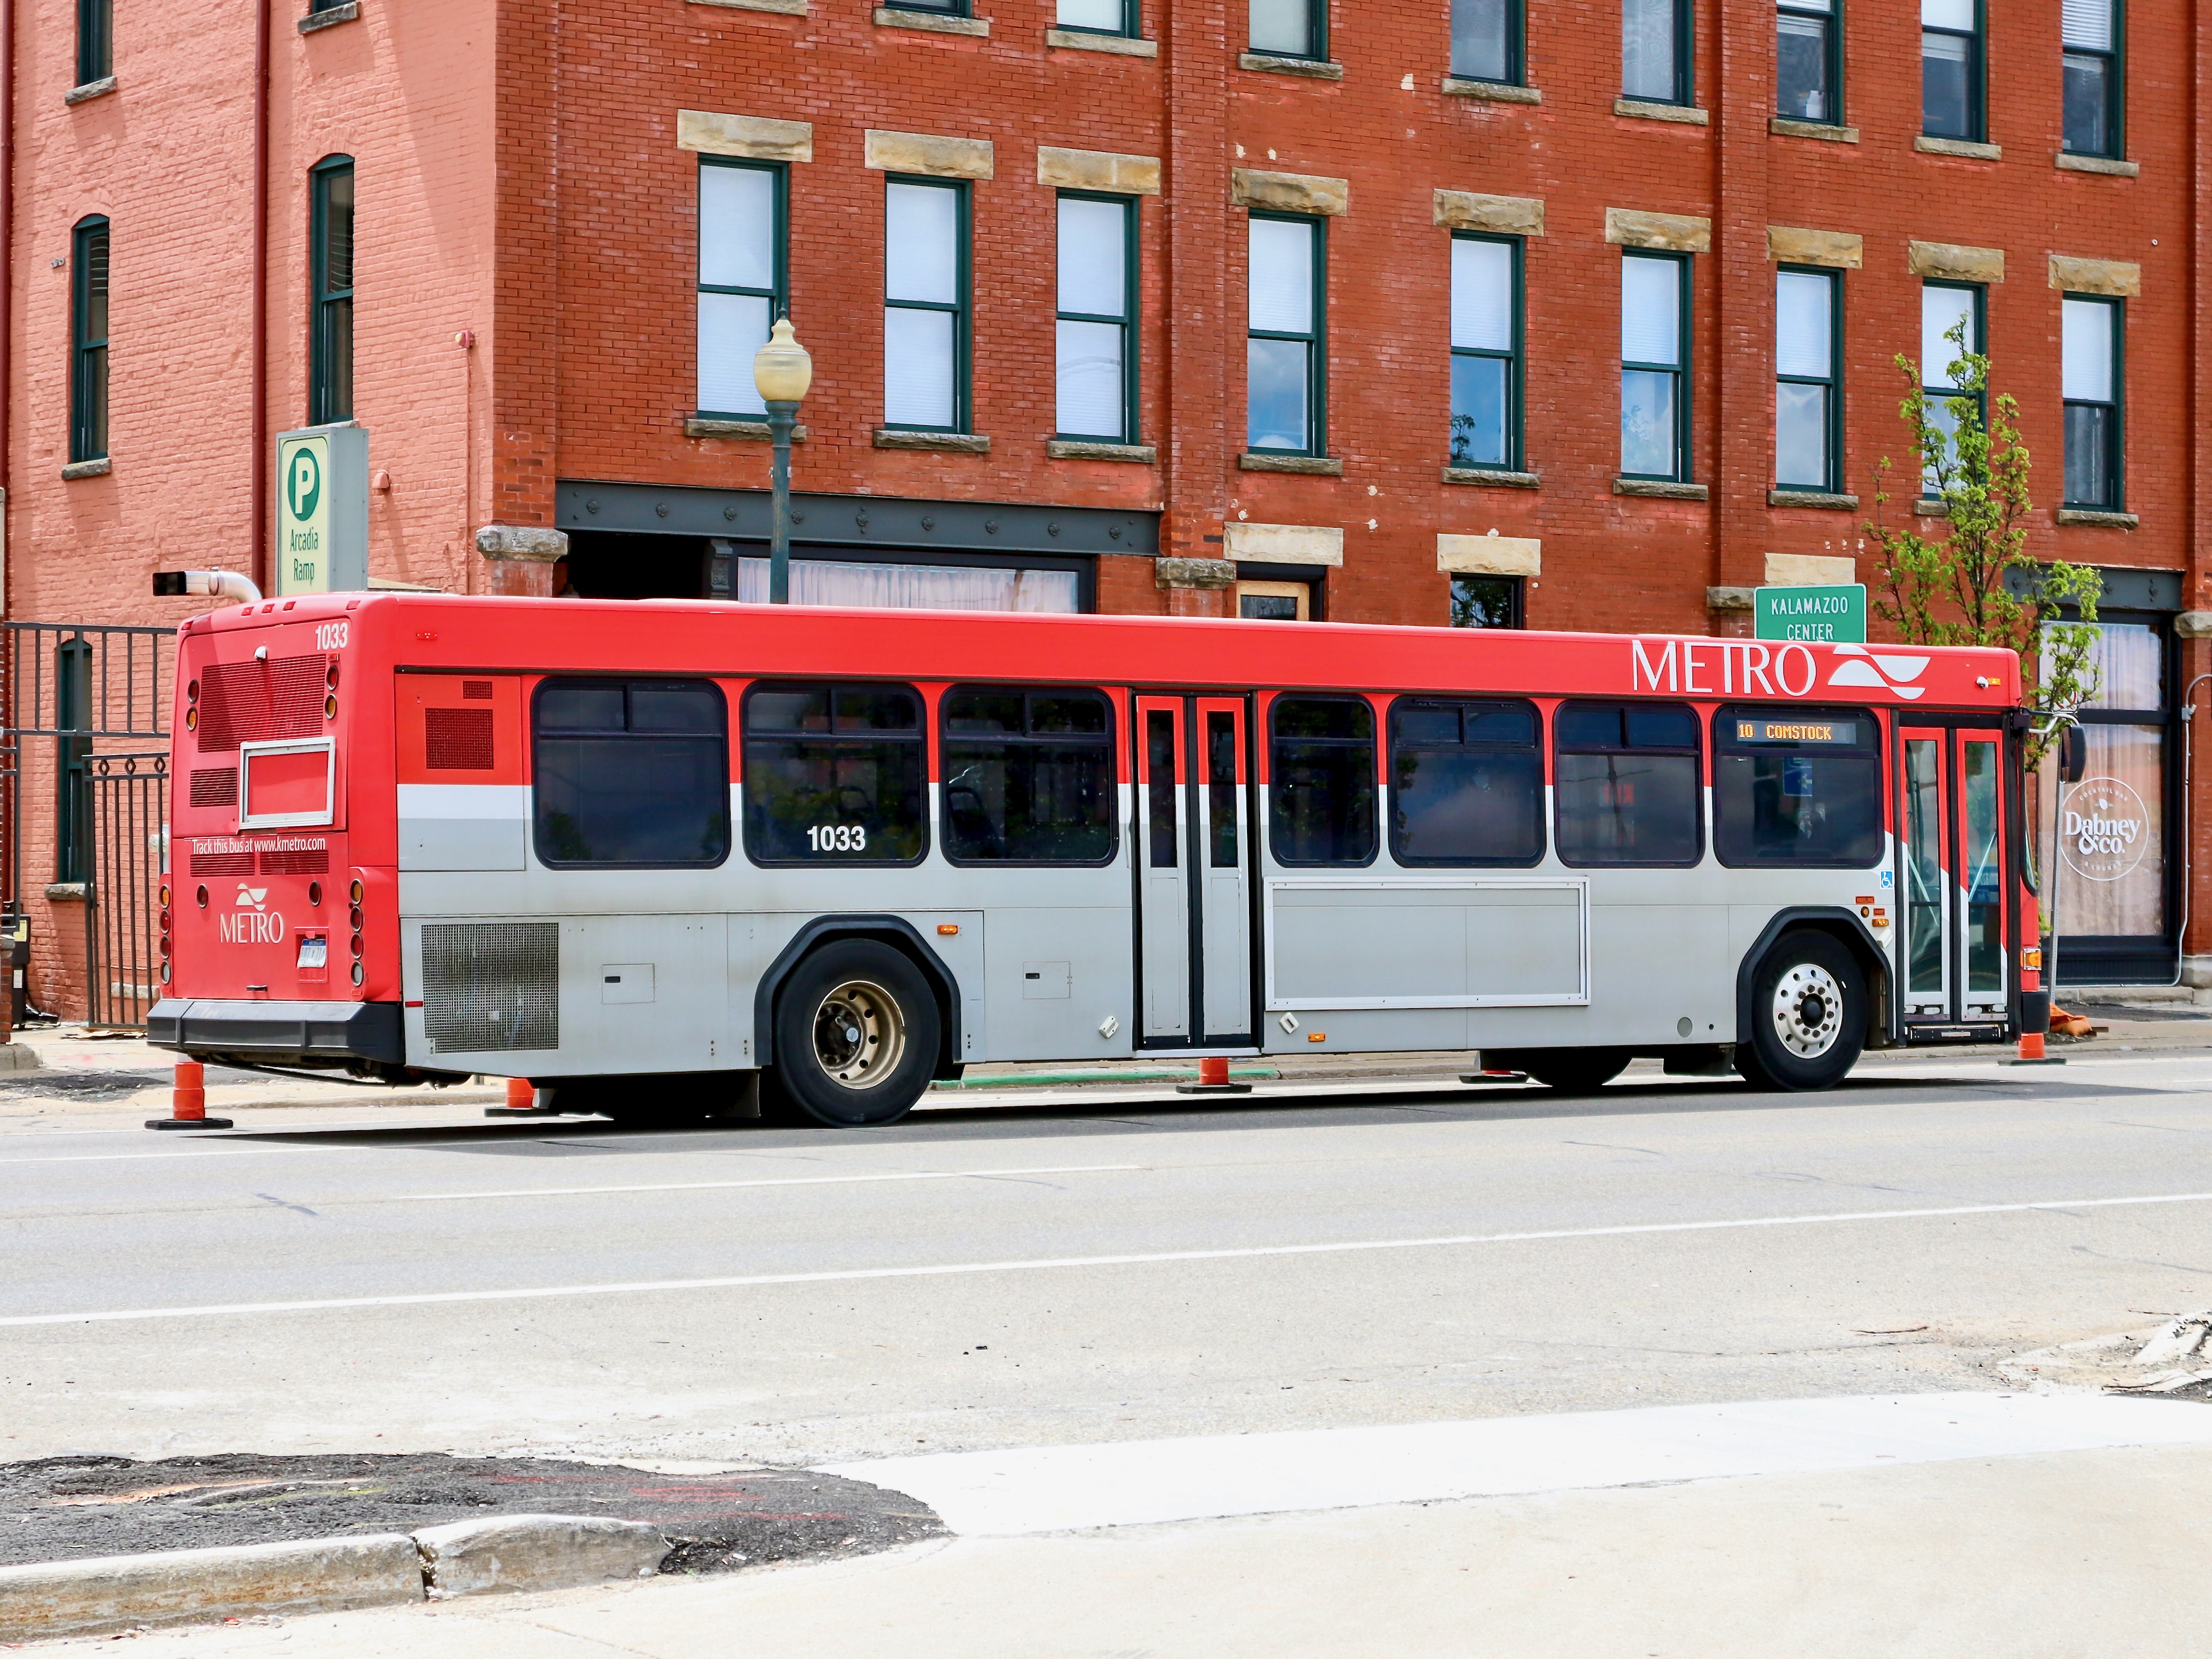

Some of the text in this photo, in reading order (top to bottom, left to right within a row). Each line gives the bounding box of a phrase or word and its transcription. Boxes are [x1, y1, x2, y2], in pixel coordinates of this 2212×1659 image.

[295, 457, 315, 514] P
[290, 527, 319, 551] Arcadia
[294, 559, 315, 585] Ramp
[1771, 596, 1848, 615] KALAMAZOO
[315, 622, 348, 651] 1033
[1787, 623, 1834, 640] CENTER
[1631, 639, 1817, 696] METRO
[1739, 724, 1832, 740] 10 COMSTOCK
[2079, 787, 2112, 801] COCKTAIL
[807, 826, 865, 851] 1033
[2065, 812, 2141, 844] Dabney
[192, 836, 326, 855] Track this bus at www.kmetro.com
[220, 912, 284, 944] METRO
